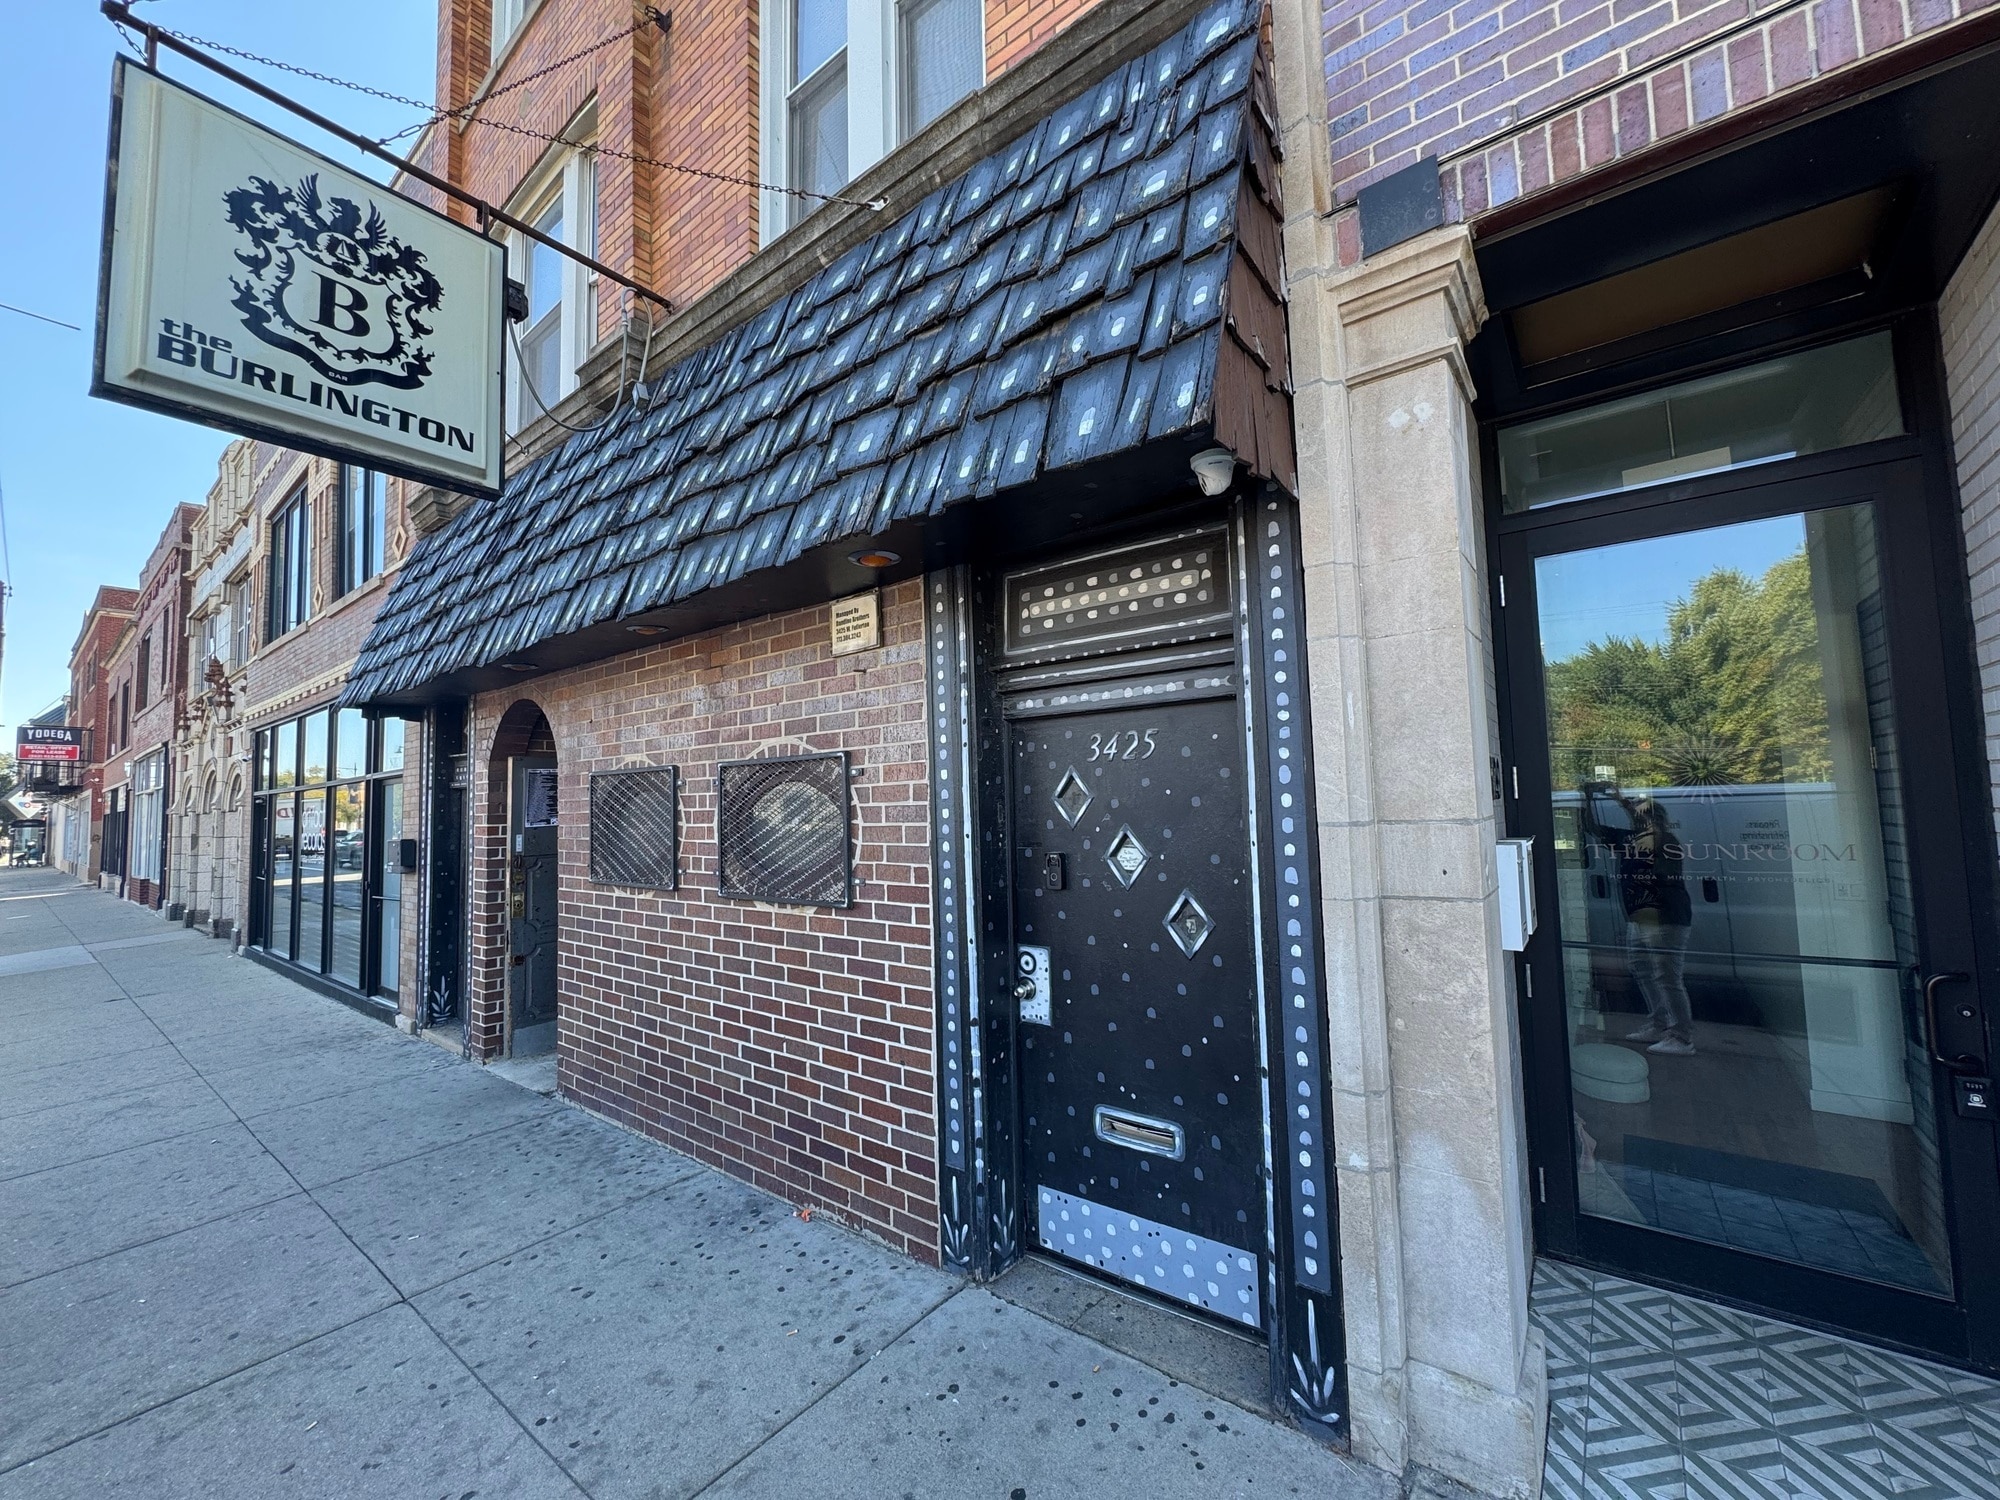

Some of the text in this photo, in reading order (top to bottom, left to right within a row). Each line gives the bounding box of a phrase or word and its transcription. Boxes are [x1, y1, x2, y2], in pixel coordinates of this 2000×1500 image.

[309, 270, 370, 337] B
[160, 317, 233, 354] the
[157, 332, 474, 453] BURLINGTON
[27, 729, 72, 741] YODEGA
[1087, 728, 1160, 763] 3425
[1585, 843, 1654, 860] THE
[1663, 843, 1857, 861] SUNROOM
[1632, 873, 1657, 881] YOGA
